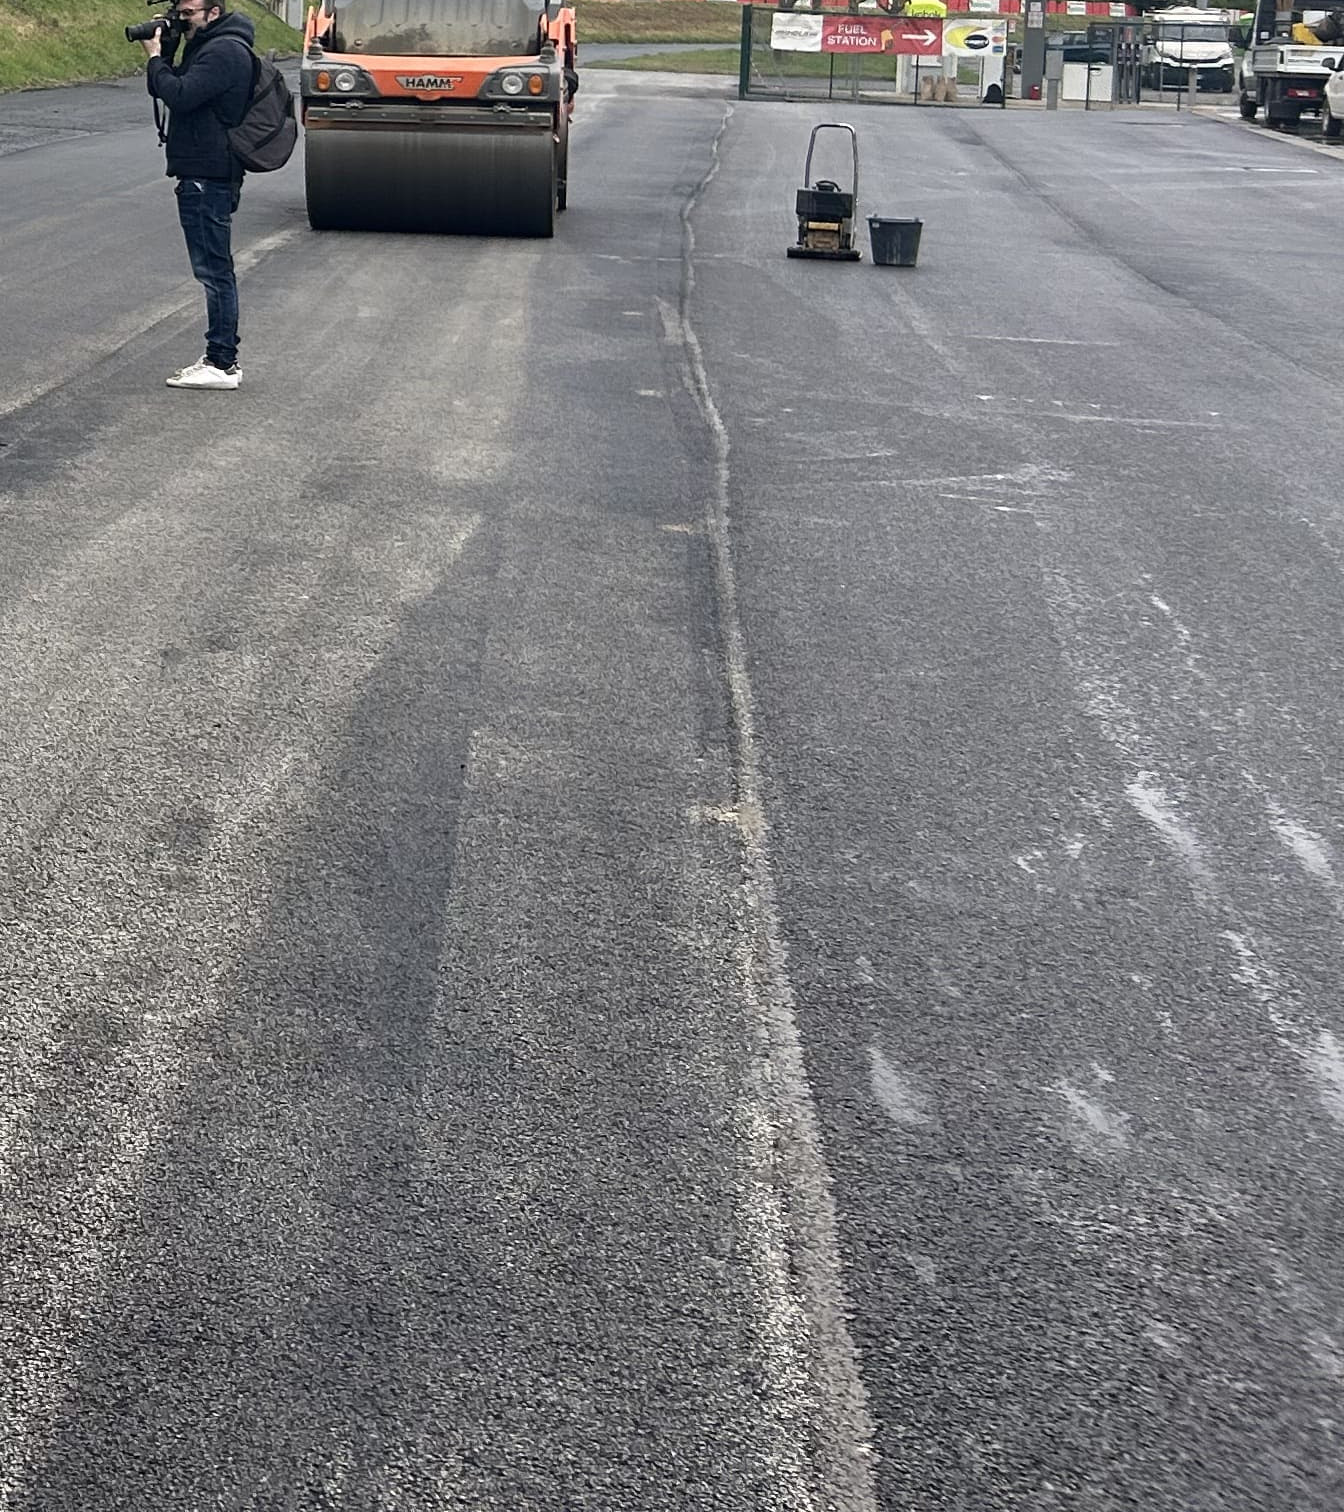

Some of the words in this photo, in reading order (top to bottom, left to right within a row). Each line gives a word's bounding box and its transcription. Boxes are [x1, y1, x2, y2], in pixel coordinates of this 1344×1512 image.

[837, 24, 868, 35] FUEL
[827, 35, 877, 47] STATION
[405, 77, 453, 89] HAMM
